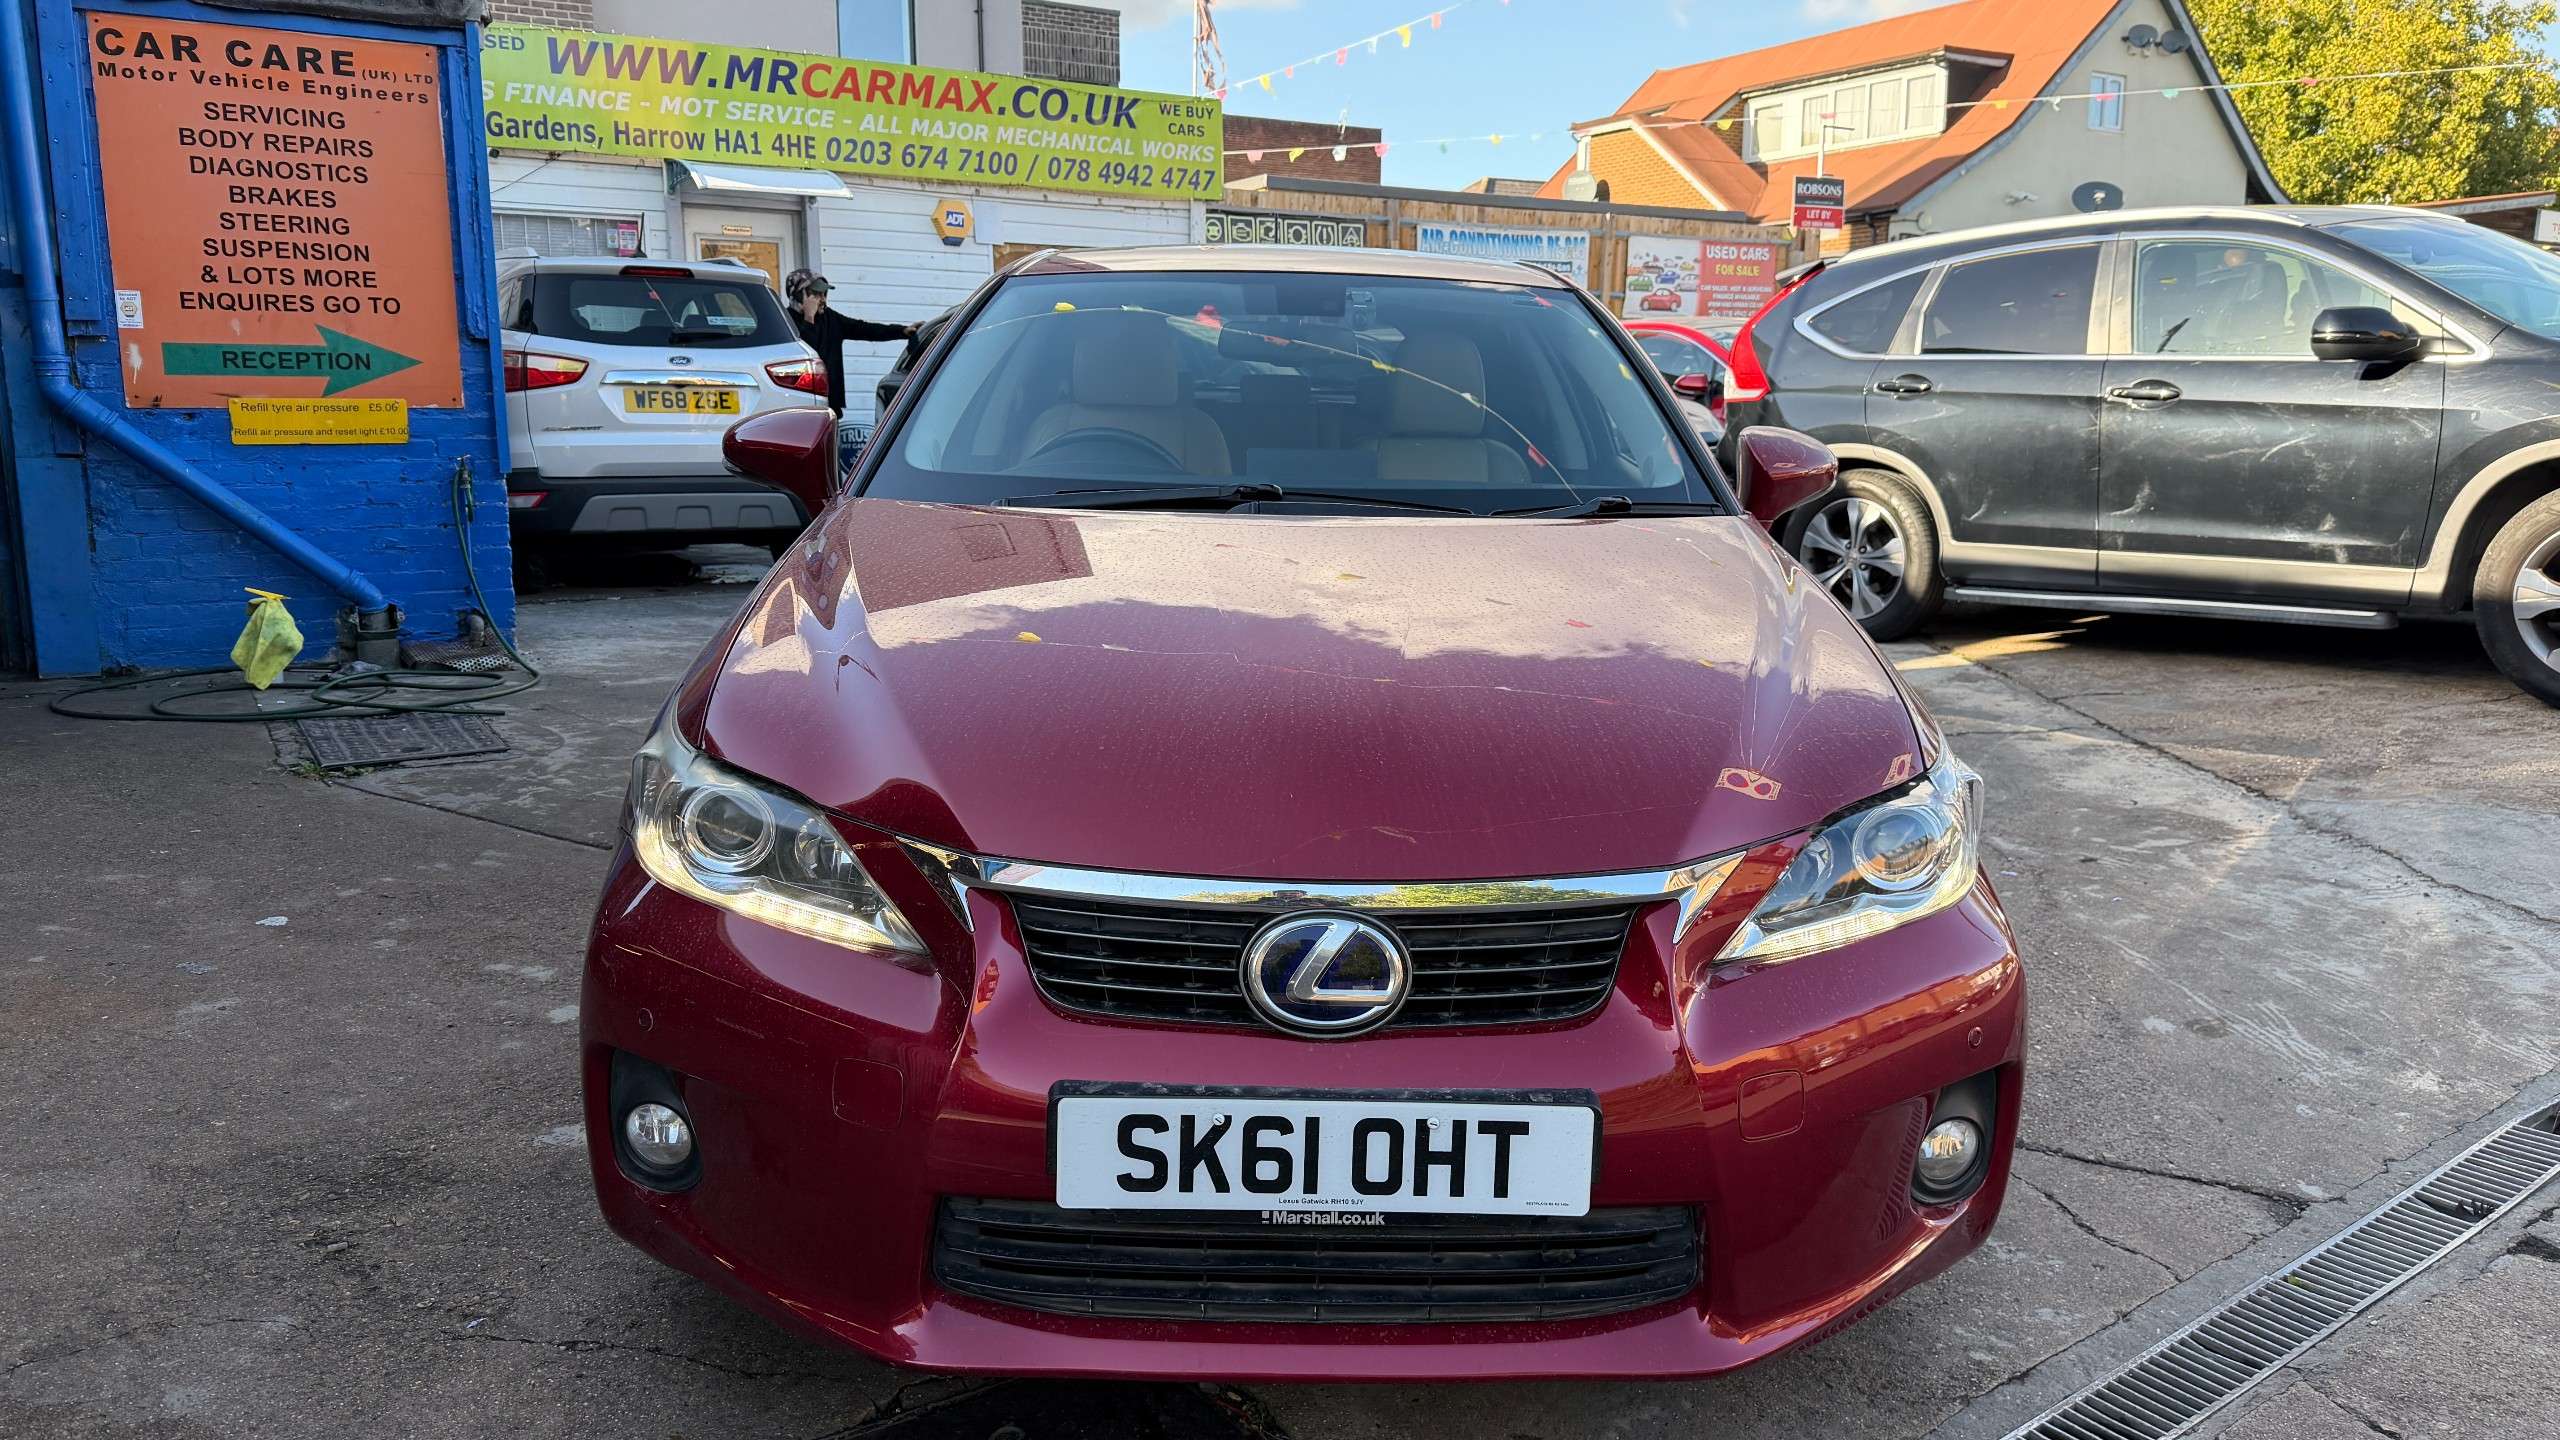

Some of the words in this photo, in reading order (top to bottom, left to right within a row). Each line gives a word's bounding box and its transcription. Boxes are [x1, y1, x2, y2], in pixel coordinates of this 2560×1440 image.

[95, 27, 202, 63] CAR
[225, 39, 356, 77] CARE
[361, 69, 397, 83] (UK)
[404, 72, 434, 85] LTD
[97, 61, 178, 82] Motor
[190, 69, 290, 91] Vehicle
[303, 79, 429, 104] Engineers
[546, 35, 1142, 129] WWW.MRCARMAX.CO.UK
[204, 102, 346, 130] SERVICING
[504, 81, 632, 112] FINANCE
[659, 95, 720, 118] MOT
[725, 101, 836, 128] SERVICE
[859, 113, 903, 135] ALL
[910, 117, 989, 143] MAJOR
[996, 125, 1136, 156] MECHANICAL
[1142, 140, 1215, 163] WORKS
[1159, 103, 1182, 117] WE
[1186, 105, 1214, 120] BUY
[1168, 122, 1205, 137] CARS
[178, 127, 255, 150] BODY
[263, 133, 374, 159] REPAIRS
[485, 110, 603, 150] Gardens,
[613, 119, 705, 151] Harrow
[714, 128, 762, 155] HA1
[771, 133, 817, 159] 4HE
[826, 136, 892, 166] 0203
[901, 143, 949, 170] 674
[958, 148, 1019, 176] 7100
[1047, 156, 1091, 182] 078
[1098, 161, 1153, 187] 4942
[1161, 167, 1216, 192] 4747
[189, 155, 369, 184] DIAGNOSTICS
[229, 185, 337, 209] BRAKES
[1797, 183, 1843, 196] ROBSONS
[219, 211, 351, 235] STEERING
[946, 212, 964, 226] ADT
[1806, 209, 1820, 219] LET
[1821, 210, 1832, 220] BY
[203, 237, 370, 262] SUSPENSION
[1706, 244, 1738, 260] USED
[1740, 246, 1770, 261] CARS
[201, 264, 219, 283] &
[227, 266, 295, 285] LOTS
[304, 268, 378, 288] MORE
[1715, 264, 1734, 275] FOR
[1736, 265, 1760, 277] SALE
[179, 291, 315, 313] ENQUIRES
[323, 295, 361, 314] GO
[368, 296, 401, 315] TO
[221, 350, 372, 371] RECEPTION
[240, 402, 269, 412] Refill
[272, 403, 293, 414] tyre
[295, 402, 310, 412] air
[313, 403, 360, 414] pressure
[634, 390, 687, 409] WF68
[692, 391, 732, 410] ZGE
[234, 427, 258, 437] Refill
[260, 428, 273, 437] air
[274, 428, 314, 438] pressure
[315, 428, 333, 436] and
[335, 429, 358, 437] reset
[359, 427, 378, 437] light
[379, 427, 409, 436] £10.00
[1116, 1113, 1321, 1195] SK61
[1351, 1117, 1530, 1199] OHT
[1272, 1210, 1386, 1226] Marshall.co.uk
